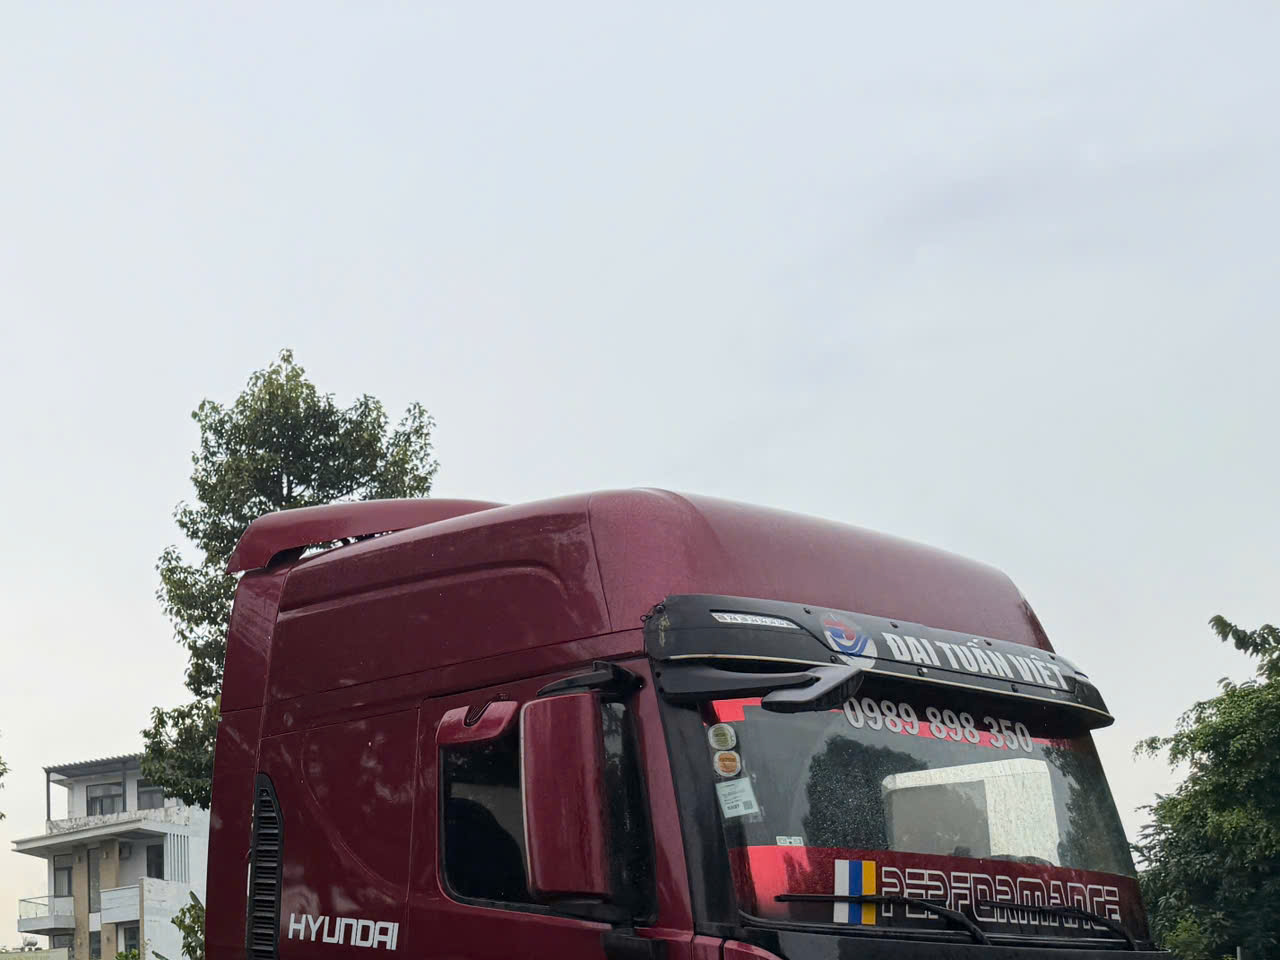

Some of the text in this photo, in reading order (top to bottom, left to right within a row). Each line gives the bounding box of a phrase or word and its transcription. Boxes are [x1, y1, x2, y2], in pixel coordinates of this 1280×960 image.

[843, 697, 1033, 753] 0989 898 350
[288, 913, 399, 950] HYUNDAI
